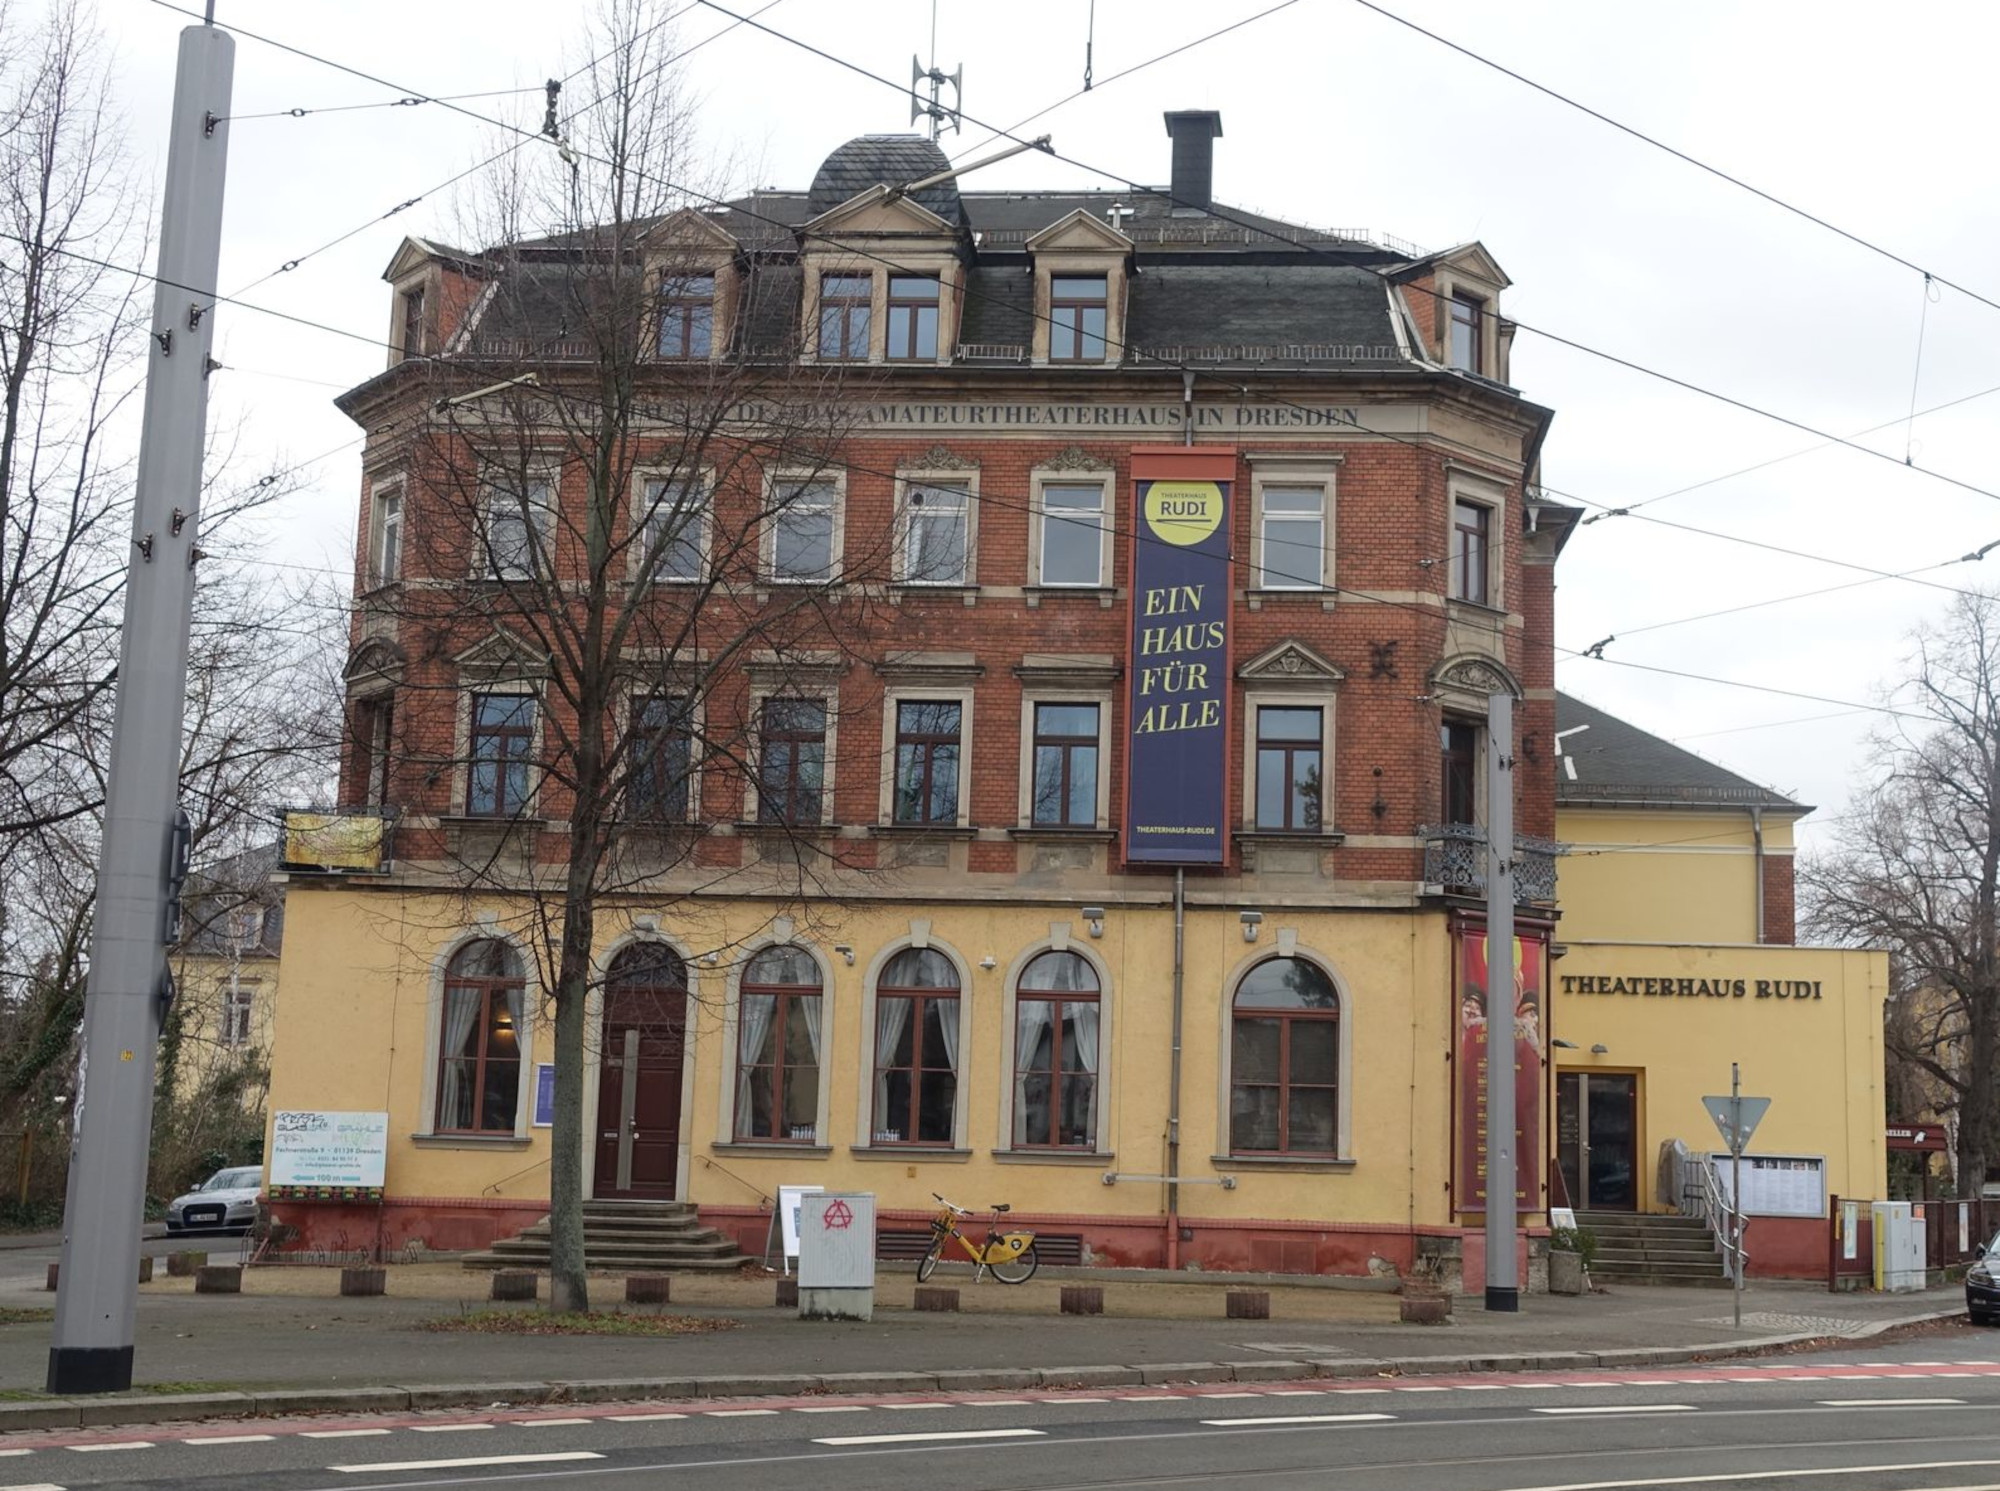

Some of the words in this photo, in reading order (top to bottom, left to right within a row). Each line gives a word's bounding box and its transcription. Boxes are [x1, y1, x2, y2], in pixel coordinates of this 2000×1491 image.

[863, 405, 1181, 424] AMATEURTHEATERHAUS
[1197, 407, 1223, 425] IN
[1236, 407, 1358, 427] DRESDEN
[1161, 501, 1206, 515] RUDI
[1143, 584, 1205, 616] EIN
[1140, 621, 1224, 655] HAUS
[1139, 660, 1209, 695] FÜR
[1135, 700, 1220, 734] ALLE
[1136, 826, 1215, 835] THEATERHAUS-RUDI.DE
[1561, 976, 1745, 998] THEATERHAUS
[1755, 980, 1822, 999] RUDI
[317, 1174, 332, 1182] 100
